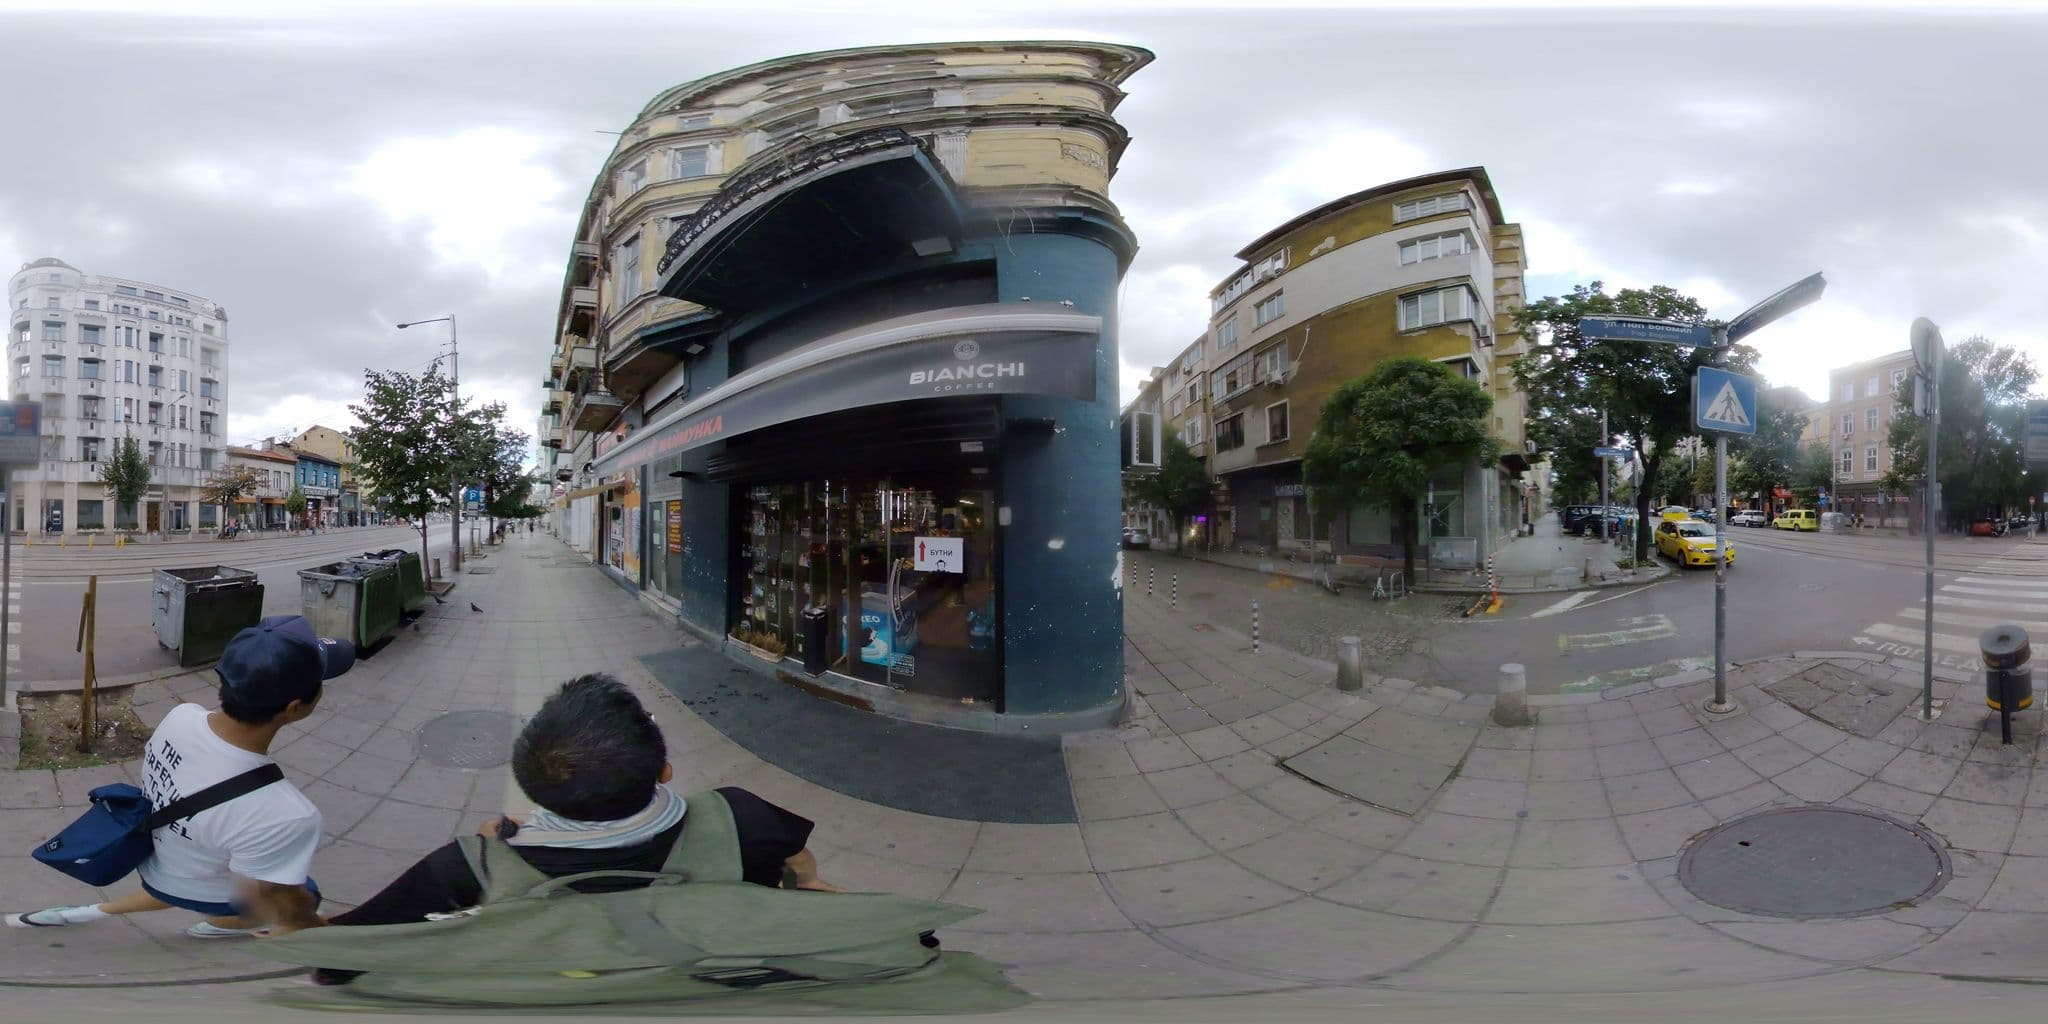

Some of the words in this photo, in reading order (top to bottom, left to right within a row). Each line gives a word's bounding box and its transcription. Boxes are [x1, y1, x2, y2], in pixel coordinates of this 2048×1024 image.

[909, 362, 1025, 385] BIANCHI
[934, 382, 995, 392] COFFEE
[930, 549, 953, 557] БУТНИ
[161, 740, 182, 770] THE
